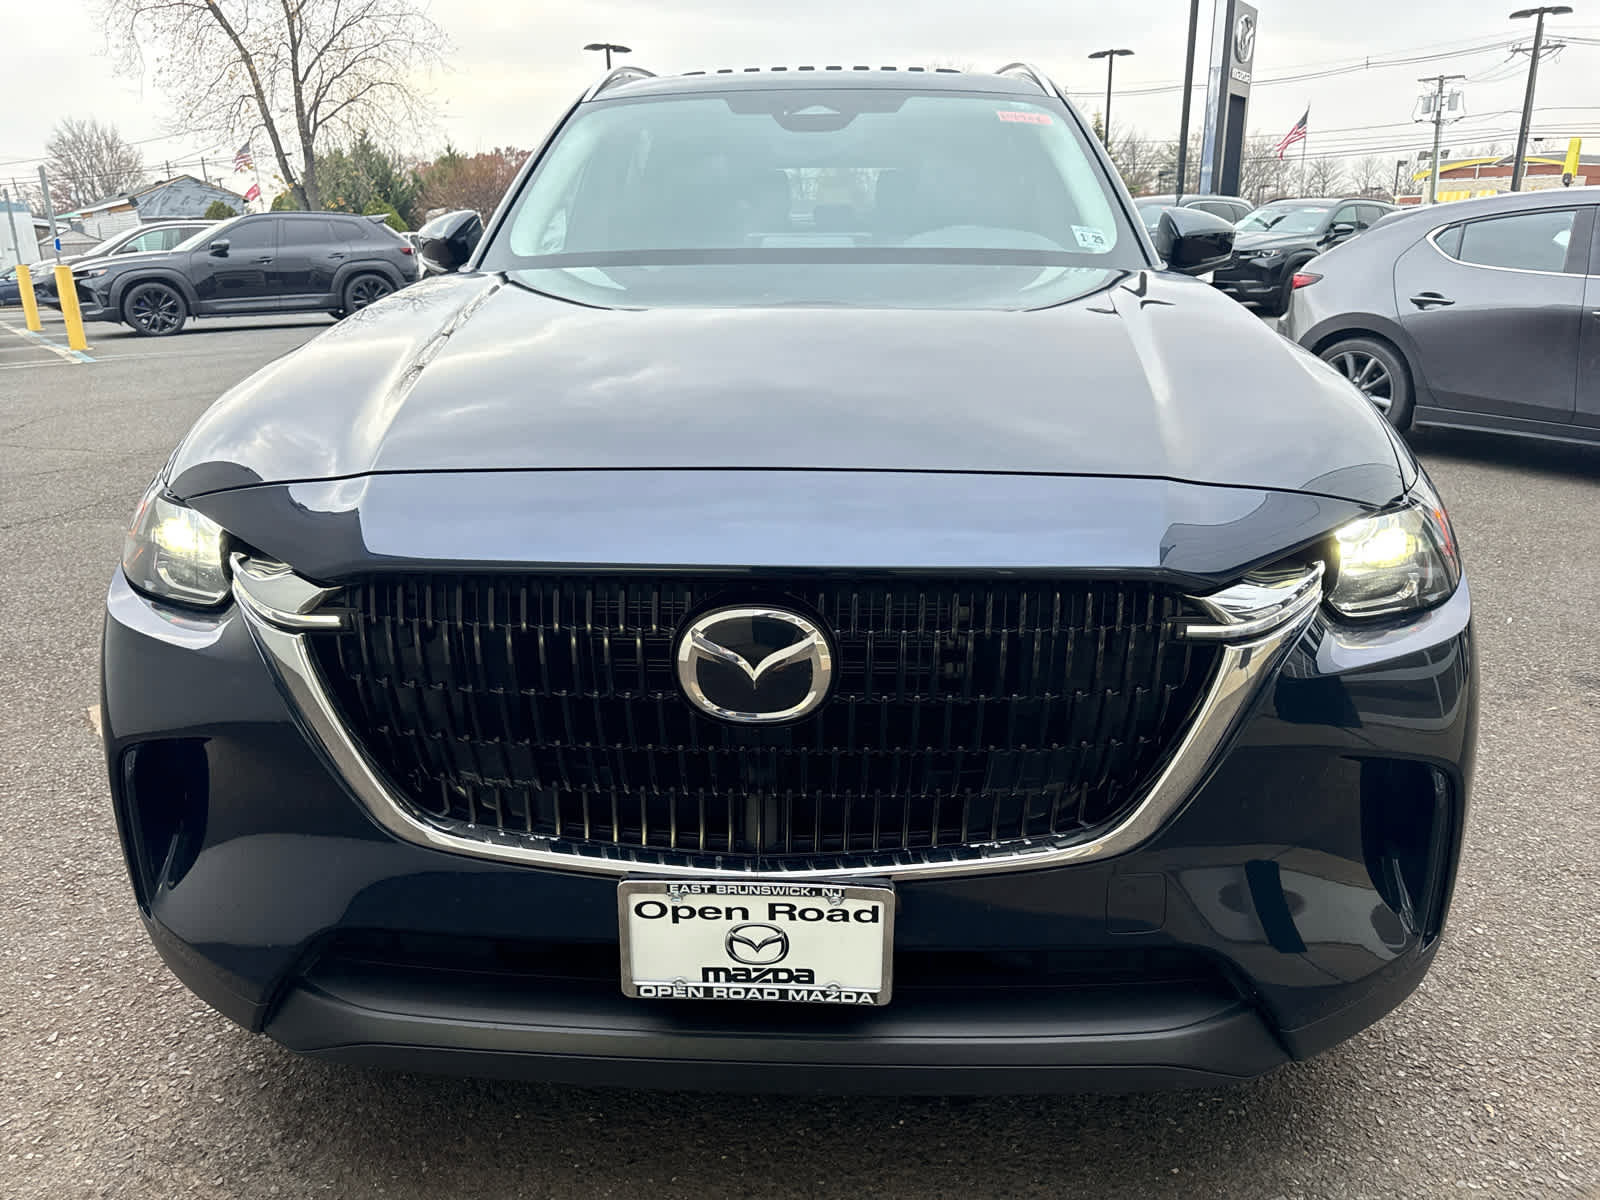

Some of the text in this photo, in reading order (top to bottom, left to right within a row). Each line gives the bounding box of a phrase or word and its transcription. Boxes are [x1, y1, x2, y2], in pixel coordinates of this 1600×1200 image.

[669, 884, 843, 898] EAST BRUNSWICK, NJ
[634, 900, 880, 924] Open Road
[639, 985, 874, 1004] OPEN ROAD MAZDA
